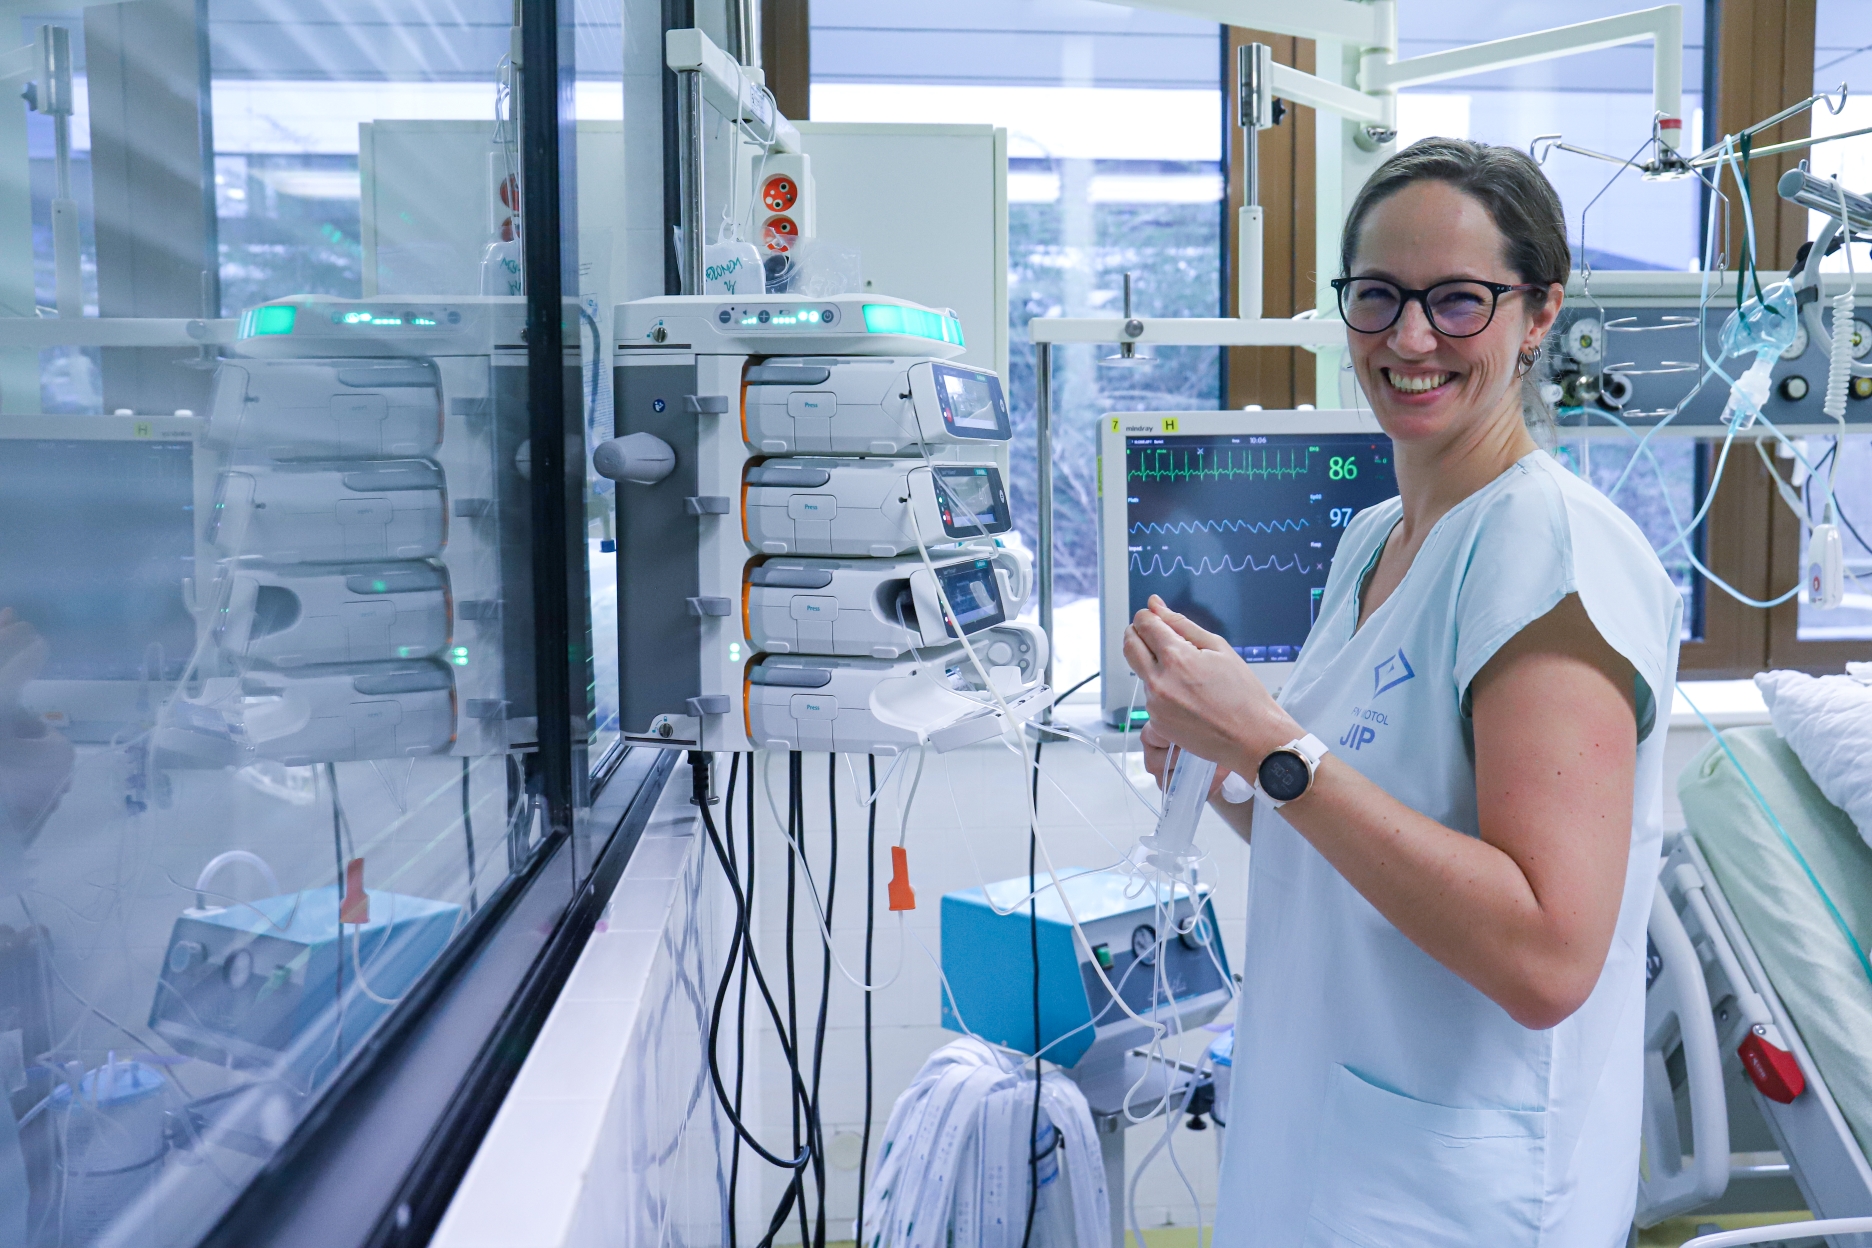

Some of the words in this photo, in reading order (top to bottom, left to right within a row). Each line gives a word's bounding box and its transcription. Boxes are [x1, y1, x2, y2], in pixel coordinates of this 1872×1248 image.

[1113, 420, 1119, 430] 7
[1126, 425, 1153, 433] mindray
[1165, 420, 1175, 430] H
[1329, 456, 1358, 480] 86
[1329, 507, 1353, 528] 97
[1340, 723, 1376, 751] JIP
